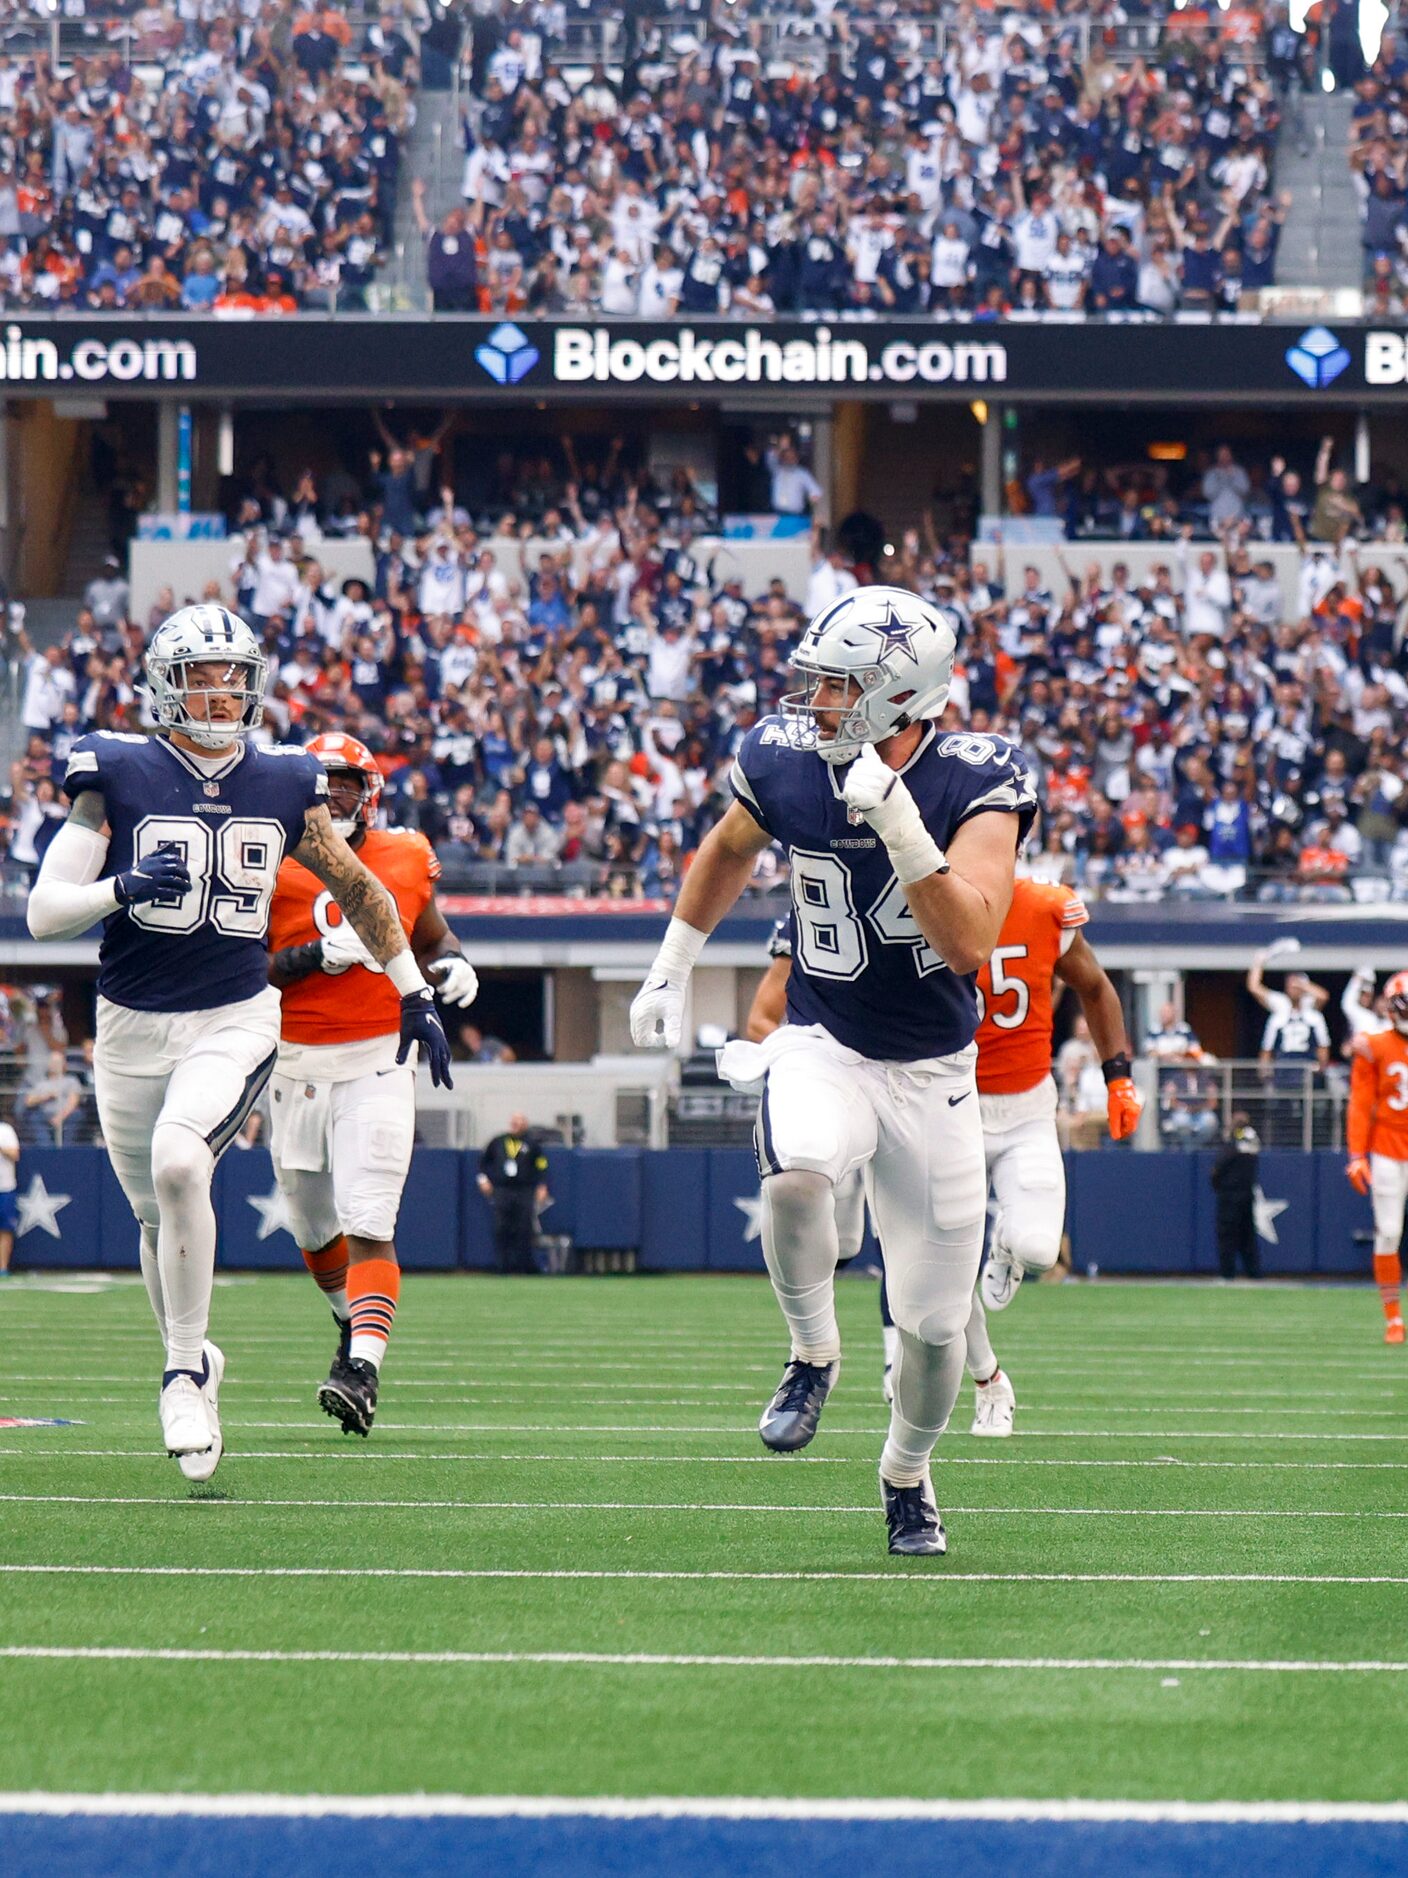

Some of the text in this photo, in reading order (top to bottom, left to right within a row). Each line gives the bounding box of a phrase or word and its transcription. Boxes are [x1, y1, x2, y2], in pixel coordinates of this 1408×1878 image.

[0, 324, 197, 381] in.com
[553, 326, 1008, 382] Blockchain.com
[128, 815, 288, 940] 89
